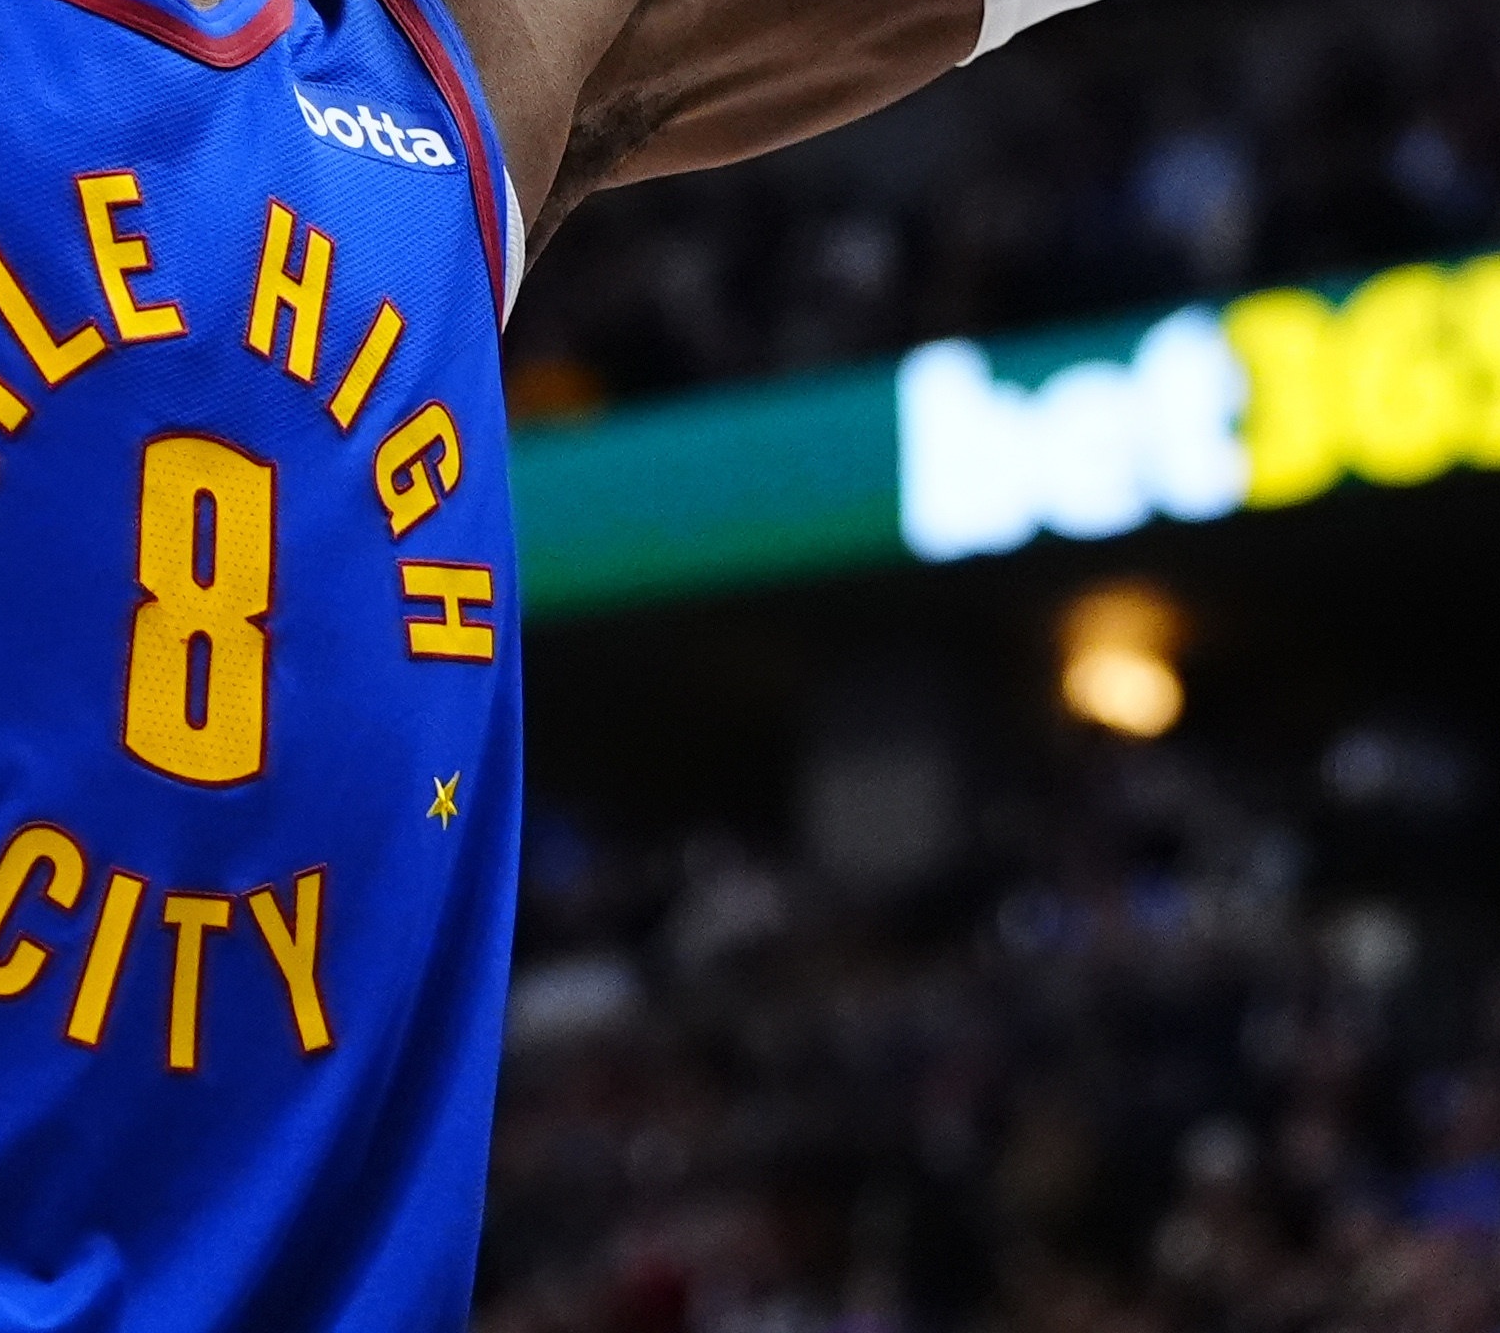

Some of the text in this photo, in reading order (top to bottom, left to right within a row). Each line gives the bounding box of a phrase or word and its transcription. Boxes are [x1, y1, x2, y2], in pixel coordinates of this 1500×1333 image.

[293, 83, 456, 167] botta
[120, 430, 277, 790] 8
[243, 197, 495, 665] HIGH
